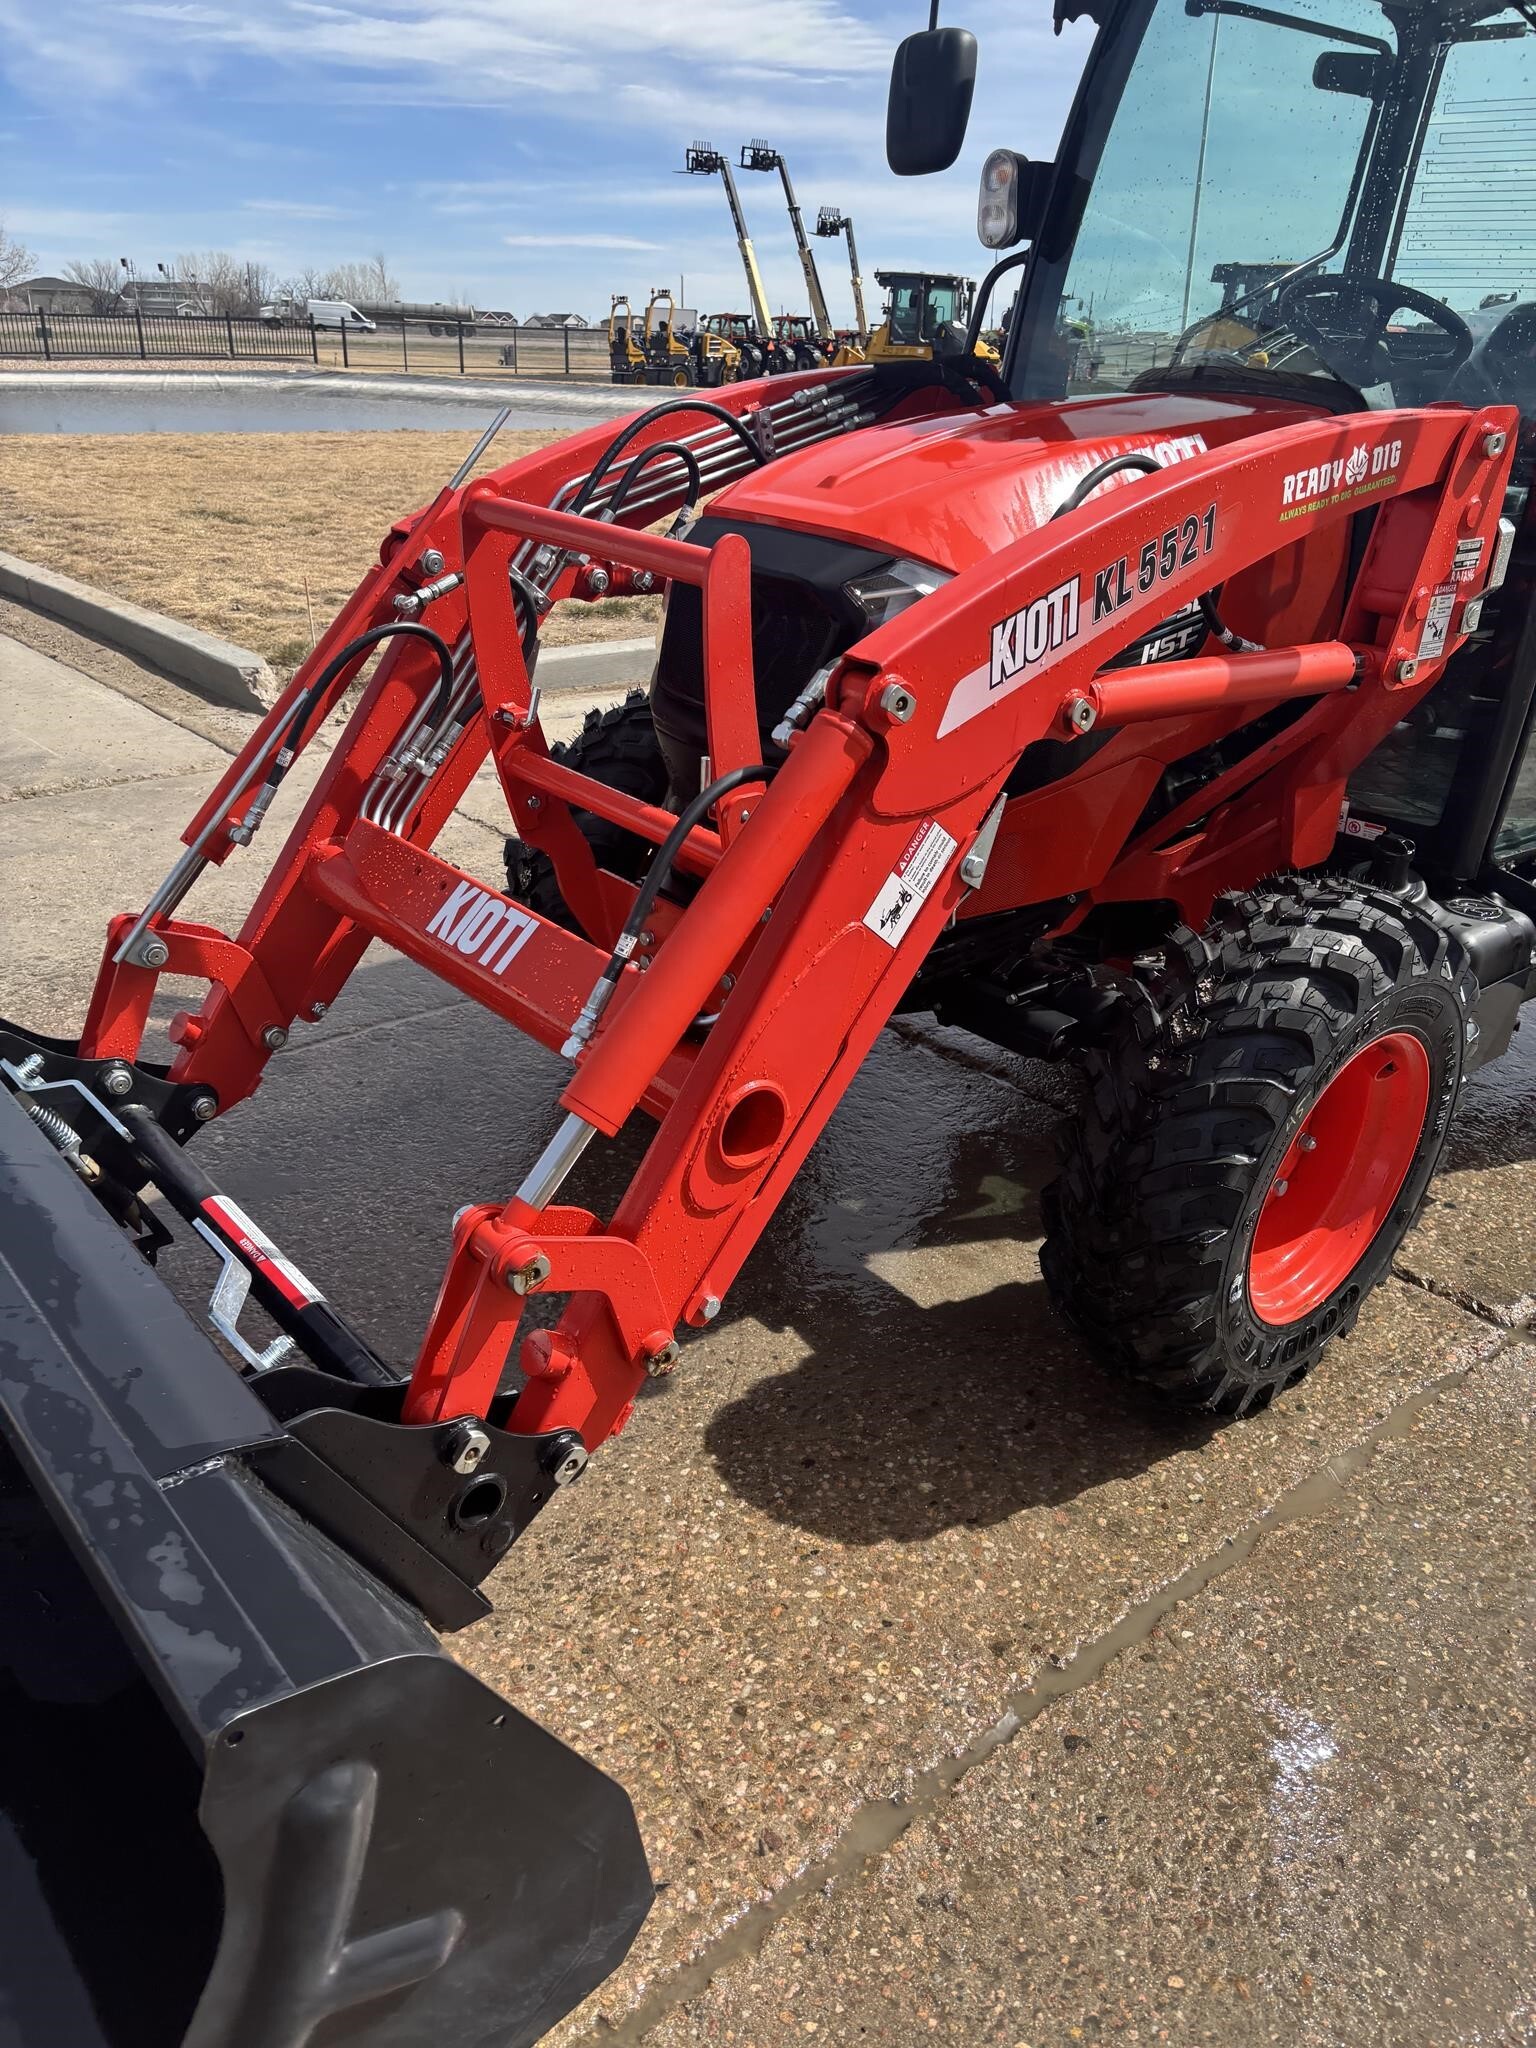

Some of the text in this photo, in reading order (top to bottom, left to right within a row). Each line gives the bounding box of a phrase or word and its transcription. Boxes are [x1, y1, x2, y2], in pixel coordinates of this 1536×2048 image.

[803, 262, 811, 277] JLG
[1282, 439, 1402, 505] READY DIG
[1279, 503, 1307, 522] ALWAYS
[1307, 498, 1330, 513] READY
[1331, 494, 1340, 504] TO
[1340, 490, 1352, 501] DIG
[1439, 584, 1457, 594] DANGER
[989, 573, 1081, 690] KIOTI
[1141, 627, 1193, 665] HST
[904, 822, 930, 861] DANGER
[425, 880, 541, 976] KIOTI
[239, 1237, 260, 1261] DANGER
